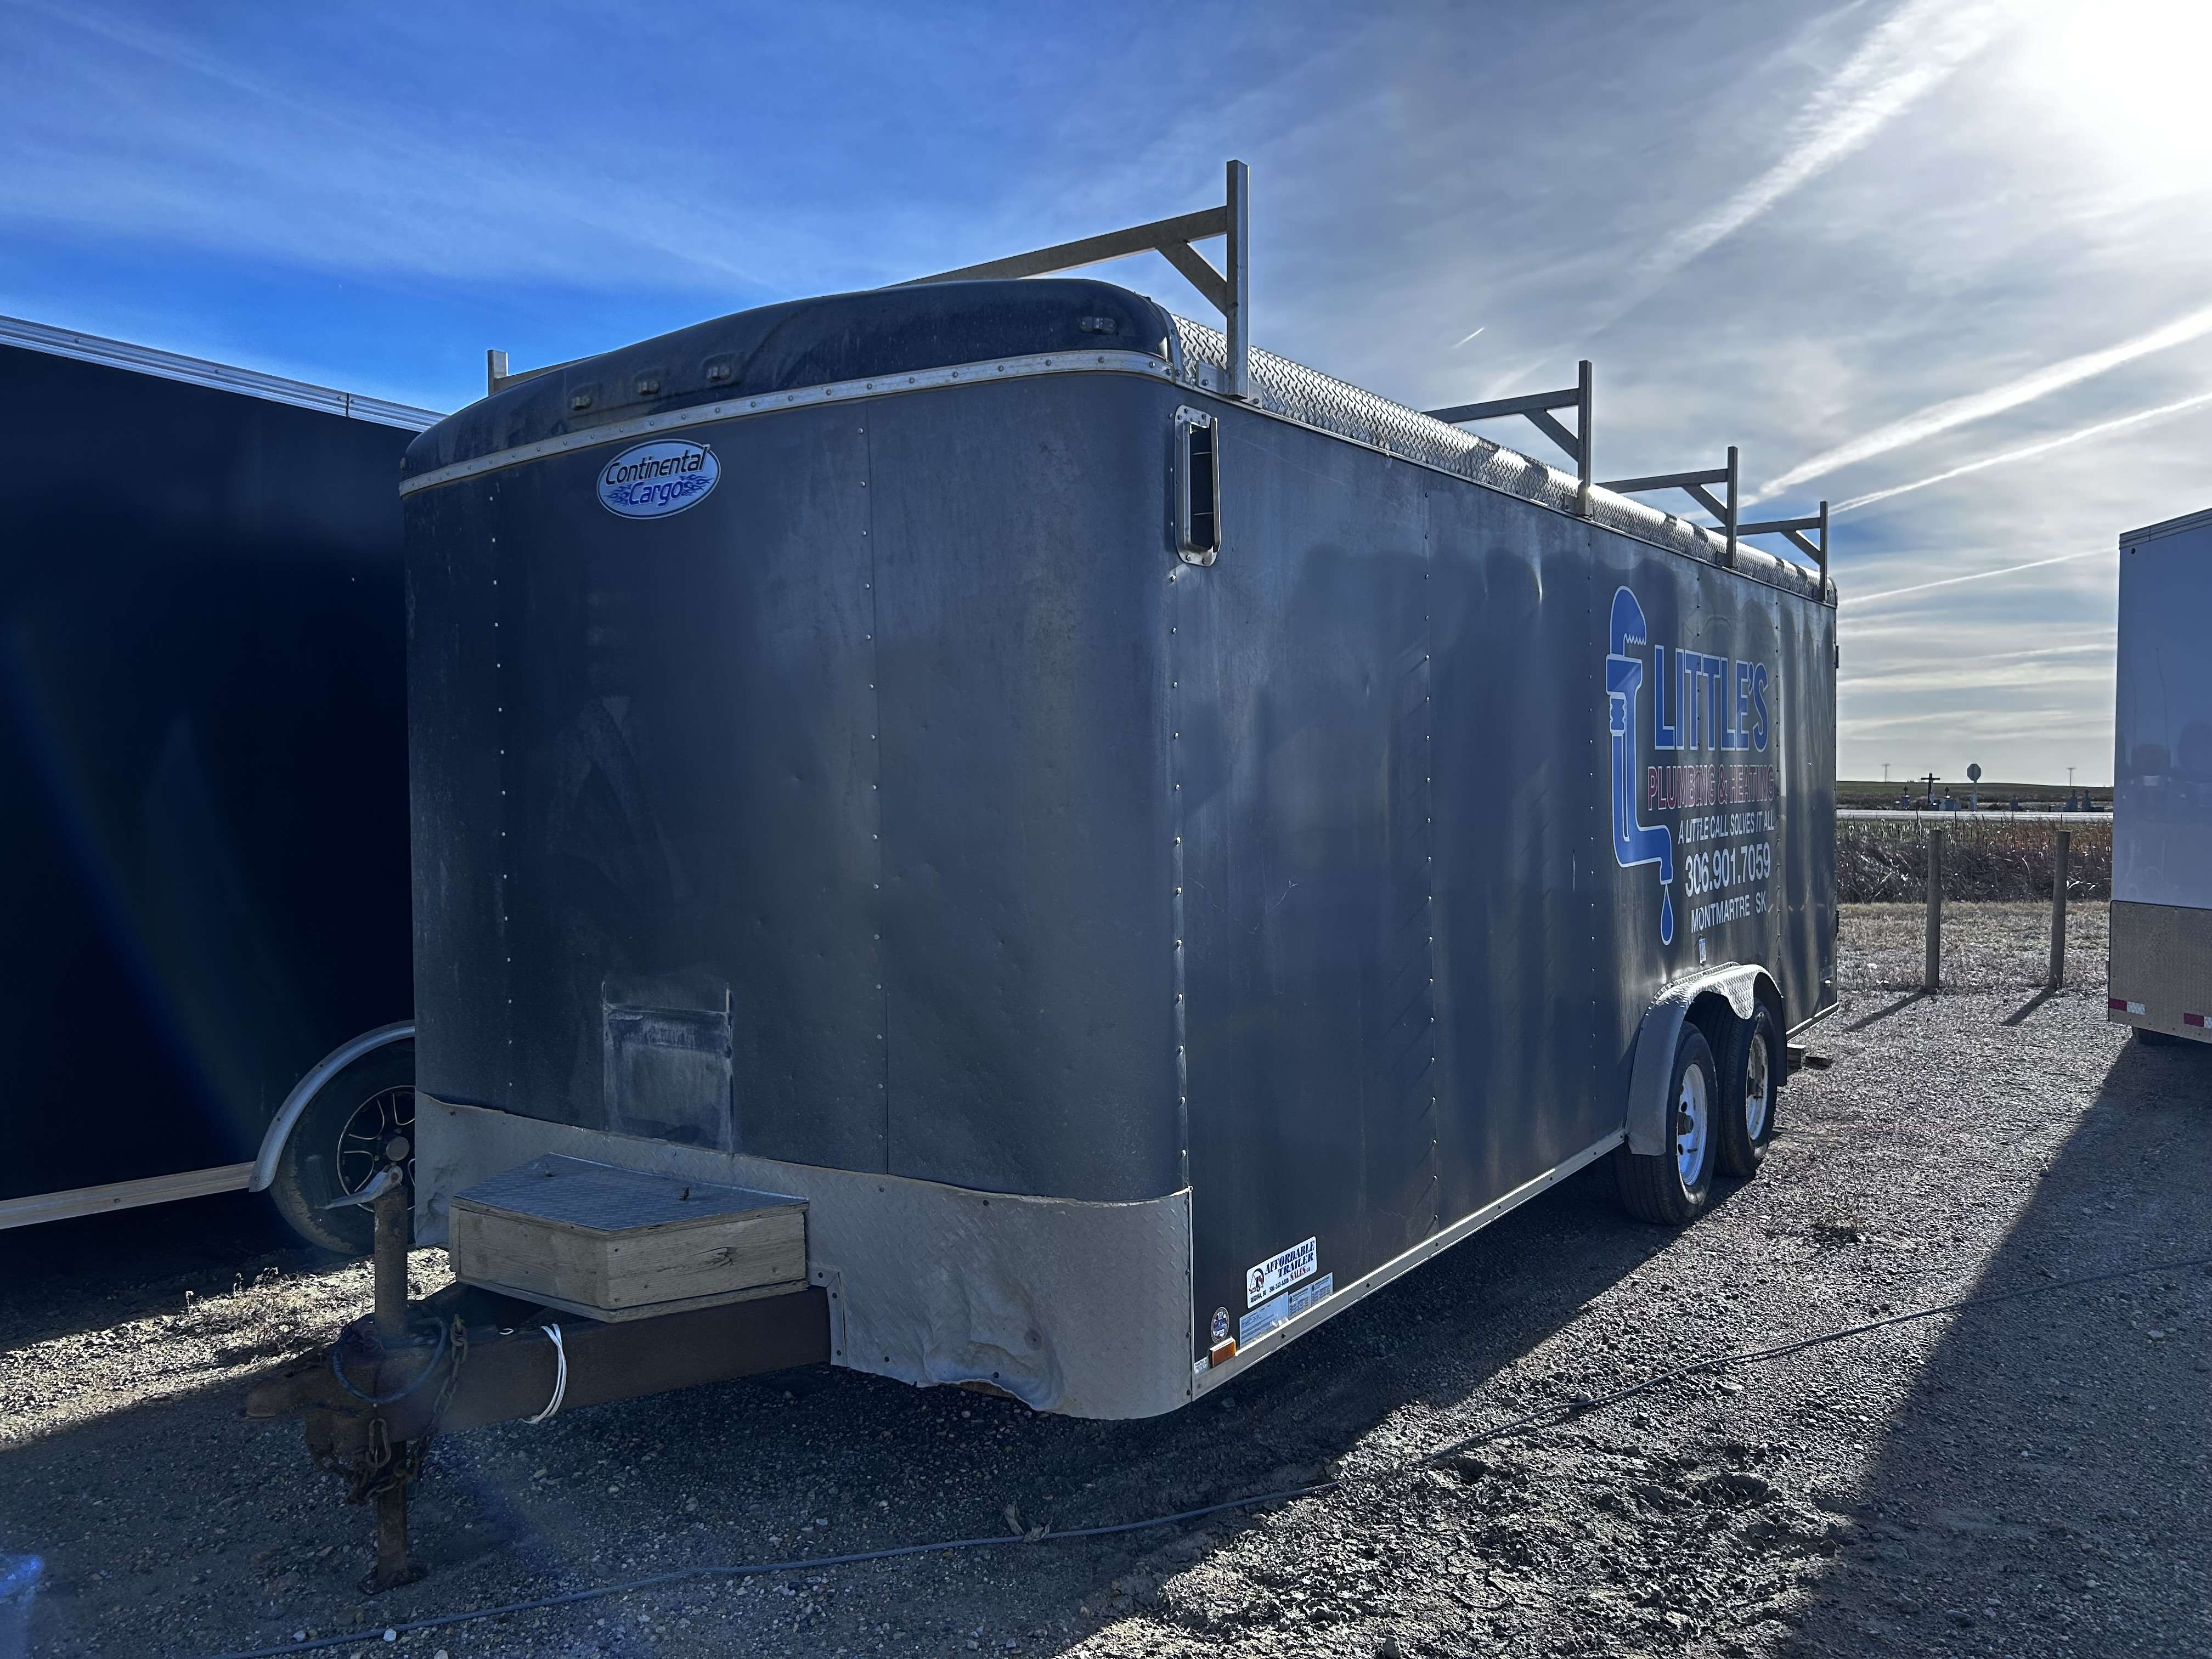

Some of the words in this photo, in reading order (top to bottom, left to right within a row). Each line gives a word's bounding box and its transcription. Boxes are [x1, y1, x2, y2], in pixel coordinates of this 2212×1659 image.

[605, 445, 710, 485] Continental
[629, 482, 684, 506] Cargo
[1654, 644, 1769, 753] LITTLE'S
[1647, 764, 1716, 811] PLUMBING
[1718, 764, 1728, 805] &
[1729, 764, 1774, 804] HEATING
[1678, 821, 1684, 844] A
[1686, 817, 1708, 843] LITTLE
[1710, 814, 1728, 839] CALL
[1730, 812, 1755, 837] SOLVES
[1756, 811, 1763, 832] IT
[1763, 810, 1774, 832] ALL
[1685, 842, 1770, 897] 306.901.7059
[1691, 894, 1750, 933] MONTMARTRE
[1756, 890, 1767, 913] SK
[1265, 1240, 1315, 1275] AFFORDABLE
[1278, 1252, 1313, 1278] TRAILER
